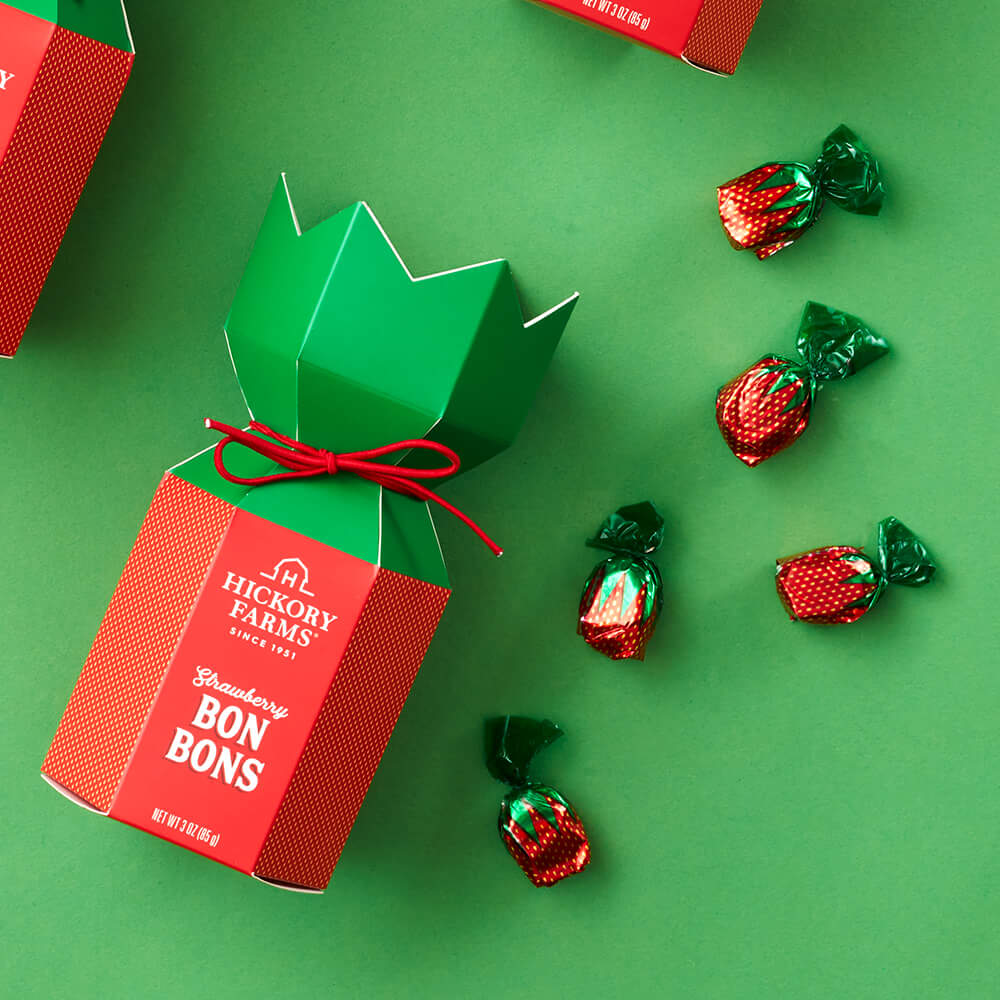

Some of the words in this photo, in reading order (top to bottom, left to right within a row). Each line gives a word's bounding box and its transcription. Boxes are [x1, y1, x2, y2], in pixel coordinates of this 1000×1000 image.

[610, 3, 618, 16] 3
[617, 6, 630, 21] OZ
[627, 10, 643, 26] (85
[222, 571, 338, 632] HICKORY
[229, 627, 267, 648] SINCE
[271, 644, 296, 660] 1951
[192, 665, 288, 720] Strawberry
[191, 693, 271, 751] BON
[165, 727, 265, 792] BONS
[152, 808, 168, 824] NET
[167, 814, 181, 829] WT
[179, 819, 188, 832] 3
[186, 822, 199, 837] OZ
[196, 827, 212, 842] (85
